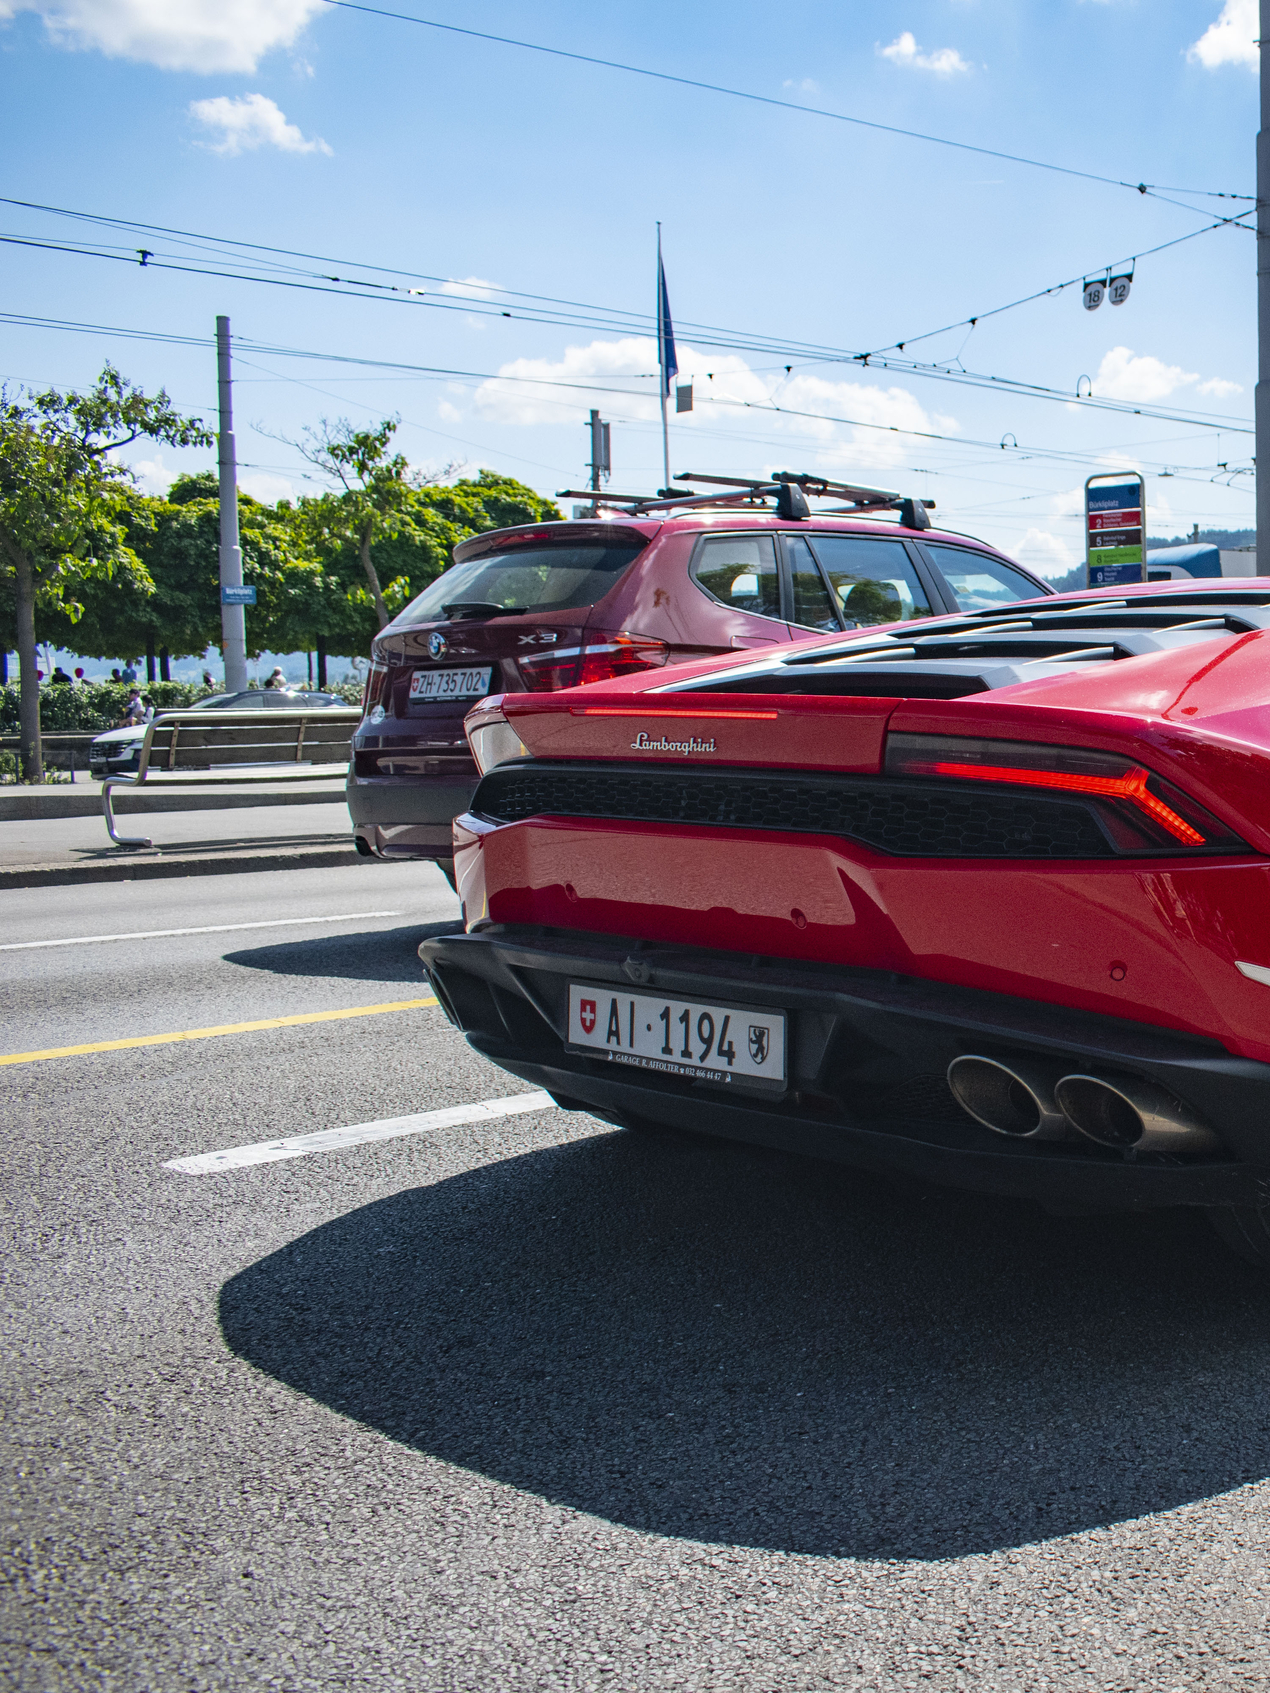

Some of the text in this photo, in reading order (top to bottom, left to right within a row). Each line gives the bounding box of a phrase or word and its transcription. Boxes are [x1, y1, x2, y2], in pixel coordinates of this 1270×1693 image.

[1087, 289, 1100, 303] 18
[1113, 284, 1126, 298] 12
[1096, 518, 1102, 528] 2
[1096, 536, 1102, 546] 5
[1096, 554, 1102, 563] 8
[1097, 572, 1103, 582] 9
[517, 632, 558, 645] X3
[630, 732, 717, 756] Lamborghini
[615, 1053, 640, 1066] GARAGE
[648, 1060, 679, 1073] AFFOLTER
[685, 1067, 695, 1076] 032
[696, 1068, 706, 1078] 466
